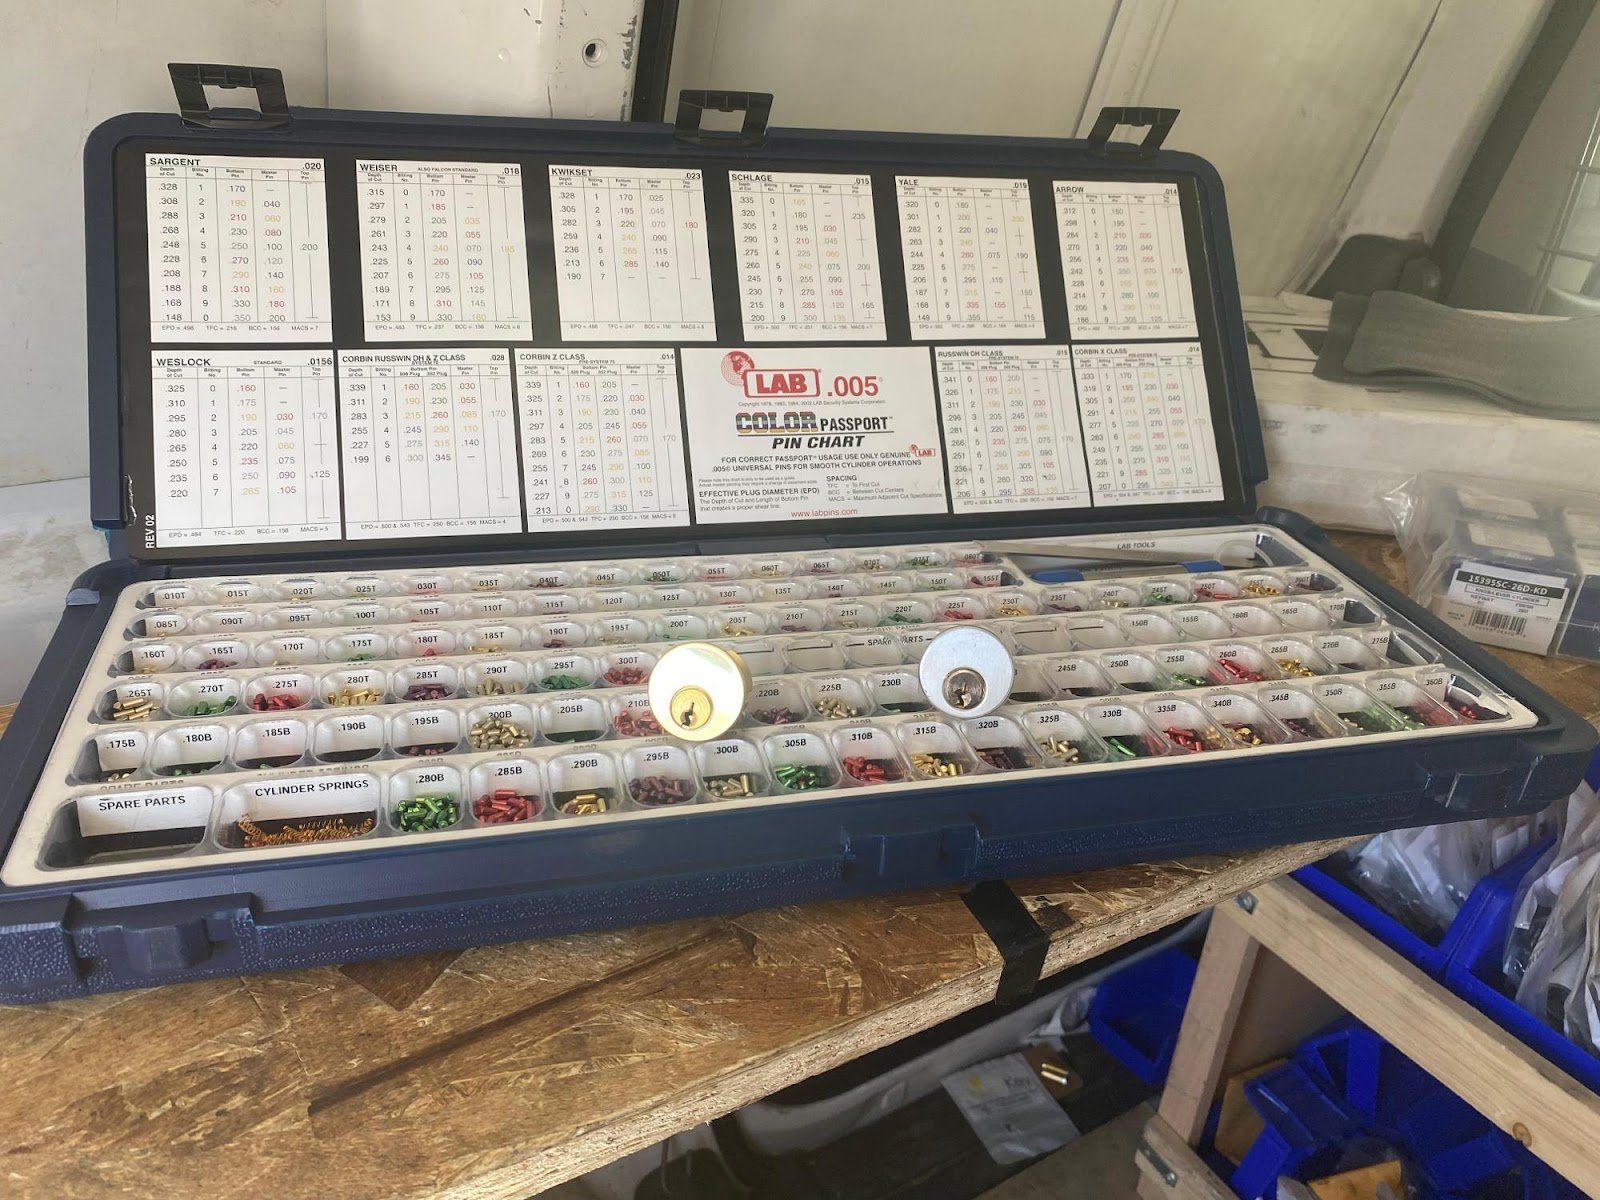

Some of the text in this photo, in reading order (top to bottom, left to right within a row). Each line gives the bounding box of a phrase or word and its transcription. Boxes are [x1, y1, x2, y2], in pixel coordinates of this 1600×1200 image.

[150, 158, 200, 166] SARGENT
[360, 164, 398, 172] WEISER
[552, 168, 592, 176] KWIKSET
[756, 374, 807, 393] LAB
[736, 412, 818, 433] COLOR
[772, 436, 865, 449] PIN CHART
[878, 459, 921, 467] OPERATIONS
[146, 514, 155, 549] REV 02
[1469, 575, 1547, 595] 15395SC-26D-KD
[344, 675, 369, 684] .280T
[198, 684, 224, 693] .270T
[273, 680, 298, 689] .275T
[557, 705, 583, 714] .205B
[1101, 710, 1122, 719] .330B
[411, 717, 439, 725] .195B
[976, 721, 999, 730] .320B
[338, 722, 366, 731] .190B
[913, 726, 936, 735] .315B
[262, 727, 291, 737] .185B
[849, 732, 873, 741] .310B
[183, 734, 212, 742] .180B
[106, 739, 135, 749] .175B
[783, 739, 806, 748] .305B
[714, 745, 738, 754] .300B
[643, 752, 669, 762] .295B
[571, 759, 598, 769] .290B
[494, 767, 522, 777] .285B
[415, 774, 445, 784] .280B
[255, 779, 369, 798] CYLINDER SPRINGS
[99, 796, 186, 811] SPARE PARTS
